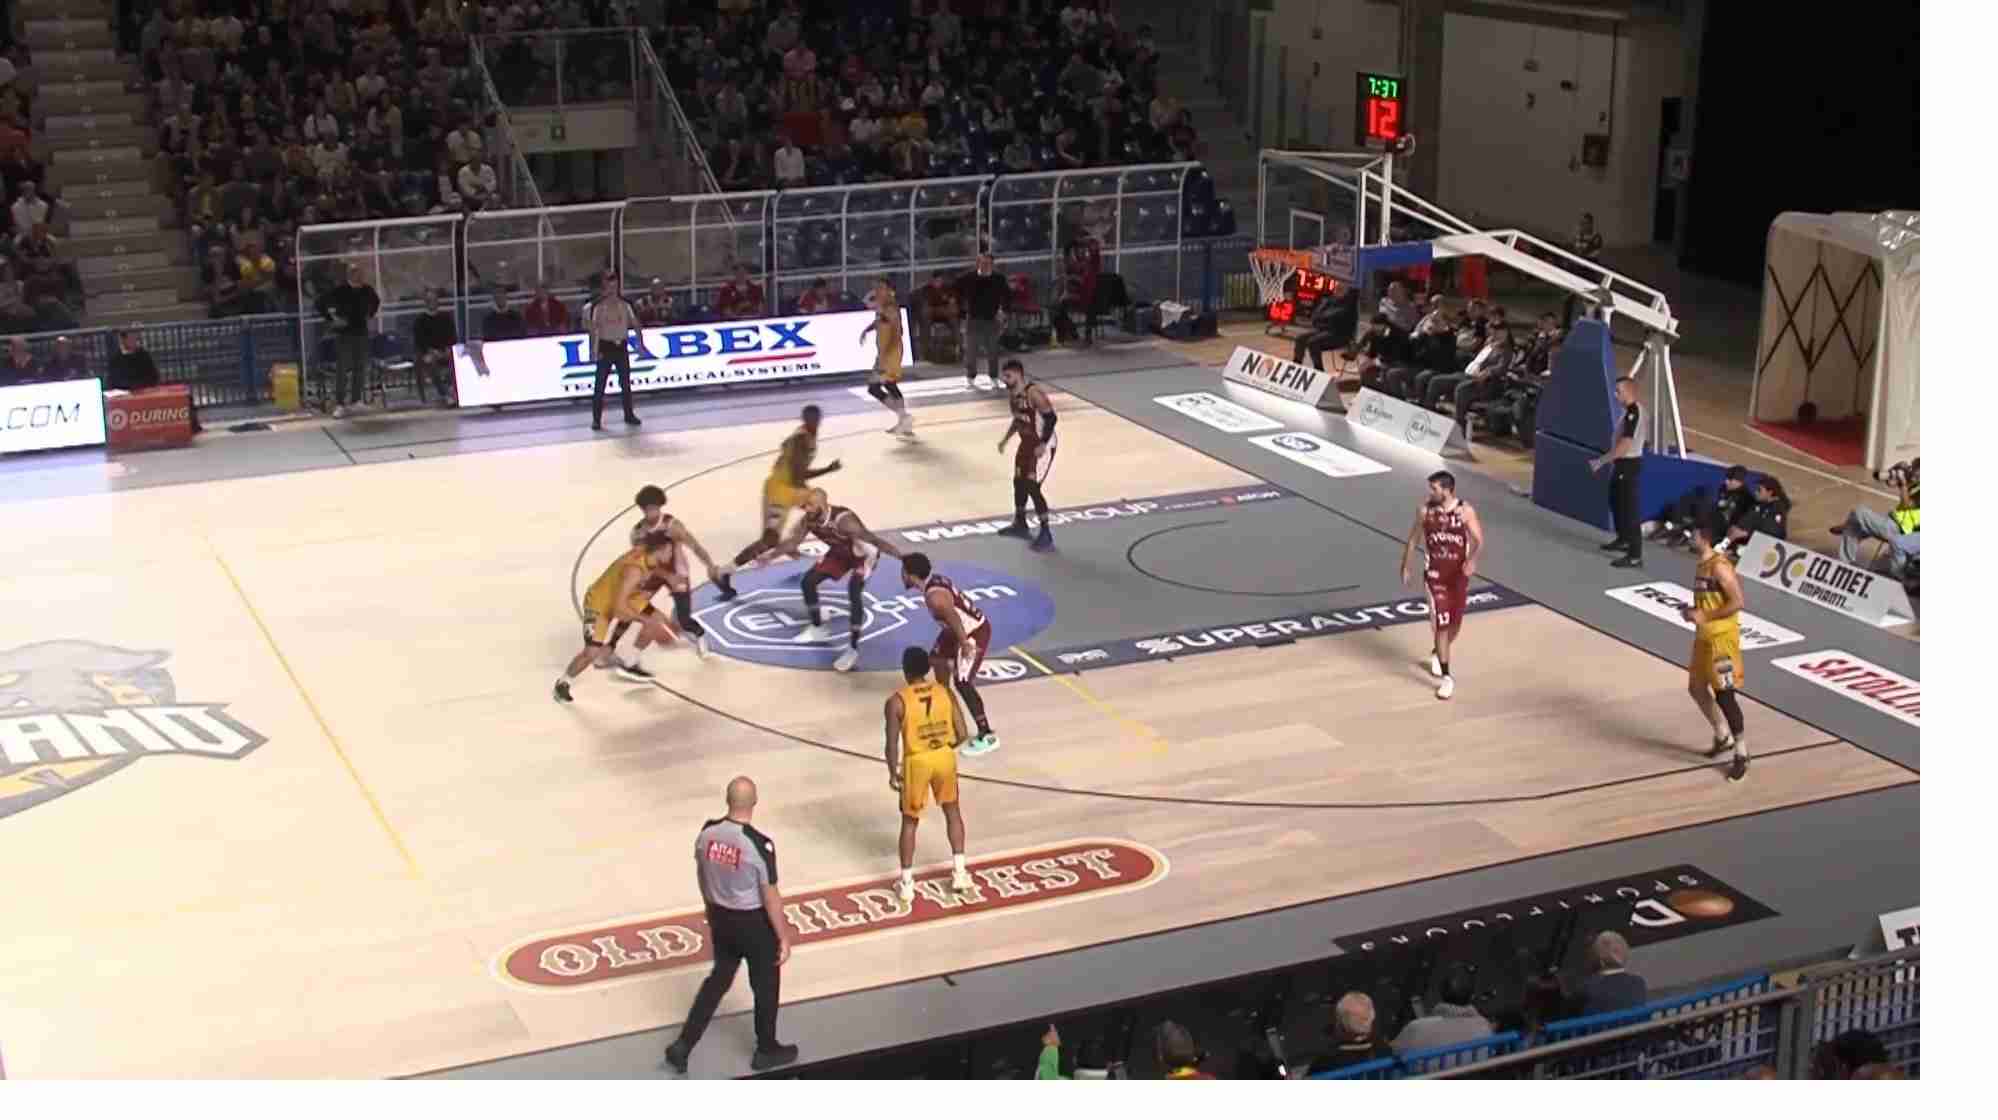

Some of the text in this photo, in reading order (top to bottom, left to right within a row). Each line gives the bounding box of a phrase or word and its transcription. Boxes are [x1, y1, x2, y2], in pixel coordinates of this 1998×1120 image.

[1368, 77, 1398, 98] 7:37
[1368, 99, 1399, 139] 12
[129, 407, 190, 425] DURING
[872, 583, 1018, 613] chm
[919, 695, 932, 717] 7
[538, 848, 1122, 976] OLD ILD WEST
